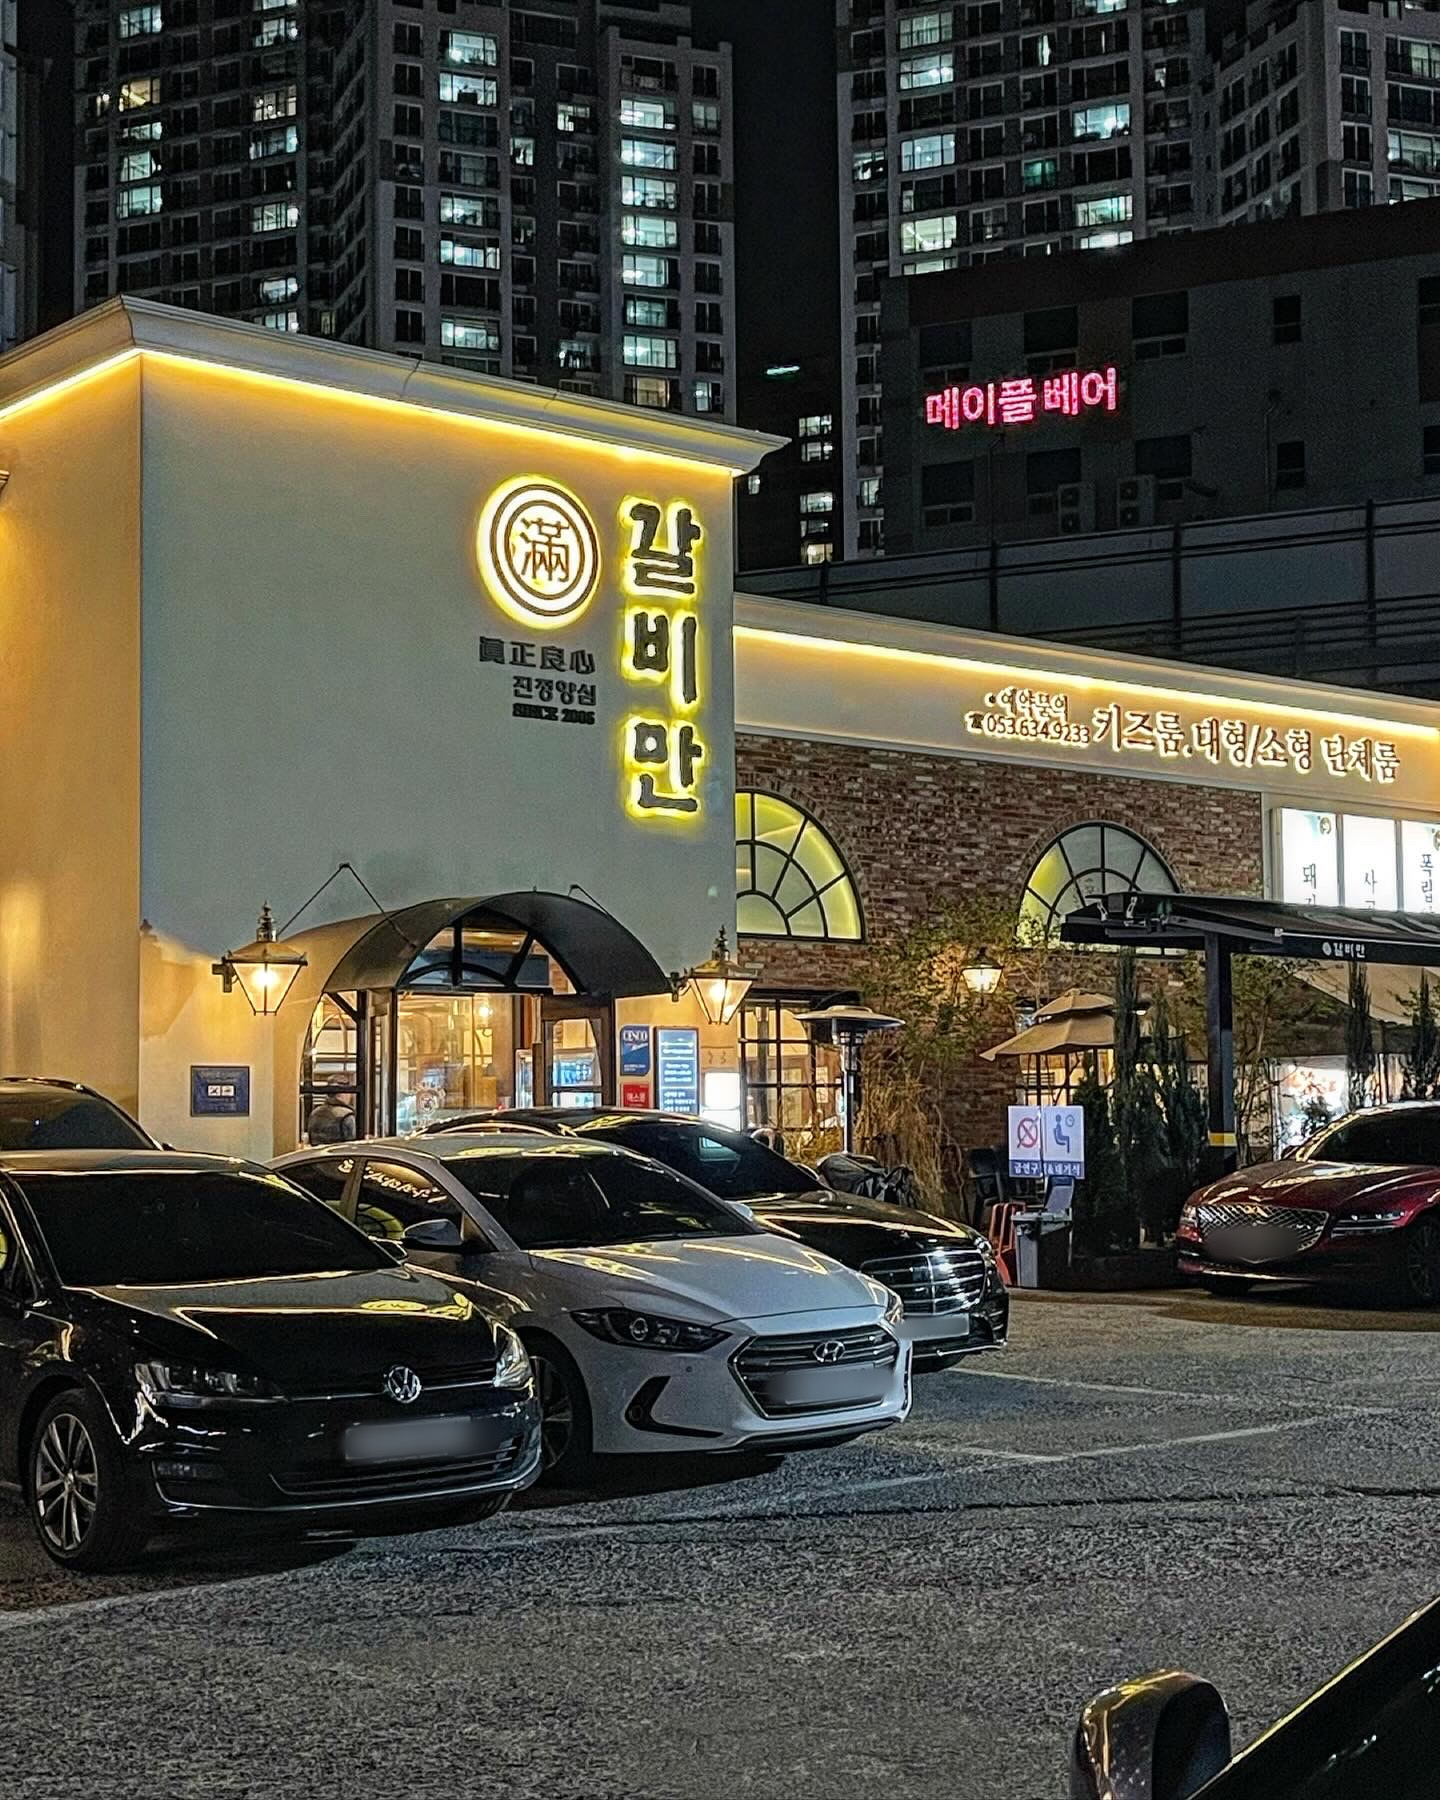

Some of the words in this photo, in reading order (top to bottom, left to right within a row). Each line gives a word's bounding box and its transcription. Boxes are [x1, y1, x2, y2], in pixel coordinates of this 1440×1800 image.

[926, 378, 1037, 430] 메이플
[1044, 367, 1116, 415] 베어
[629, 502, 702, 813] 갈비만
[512, 675, 597, 706] 진정양심
[1323, 734, 1401, 780] 단체룸
